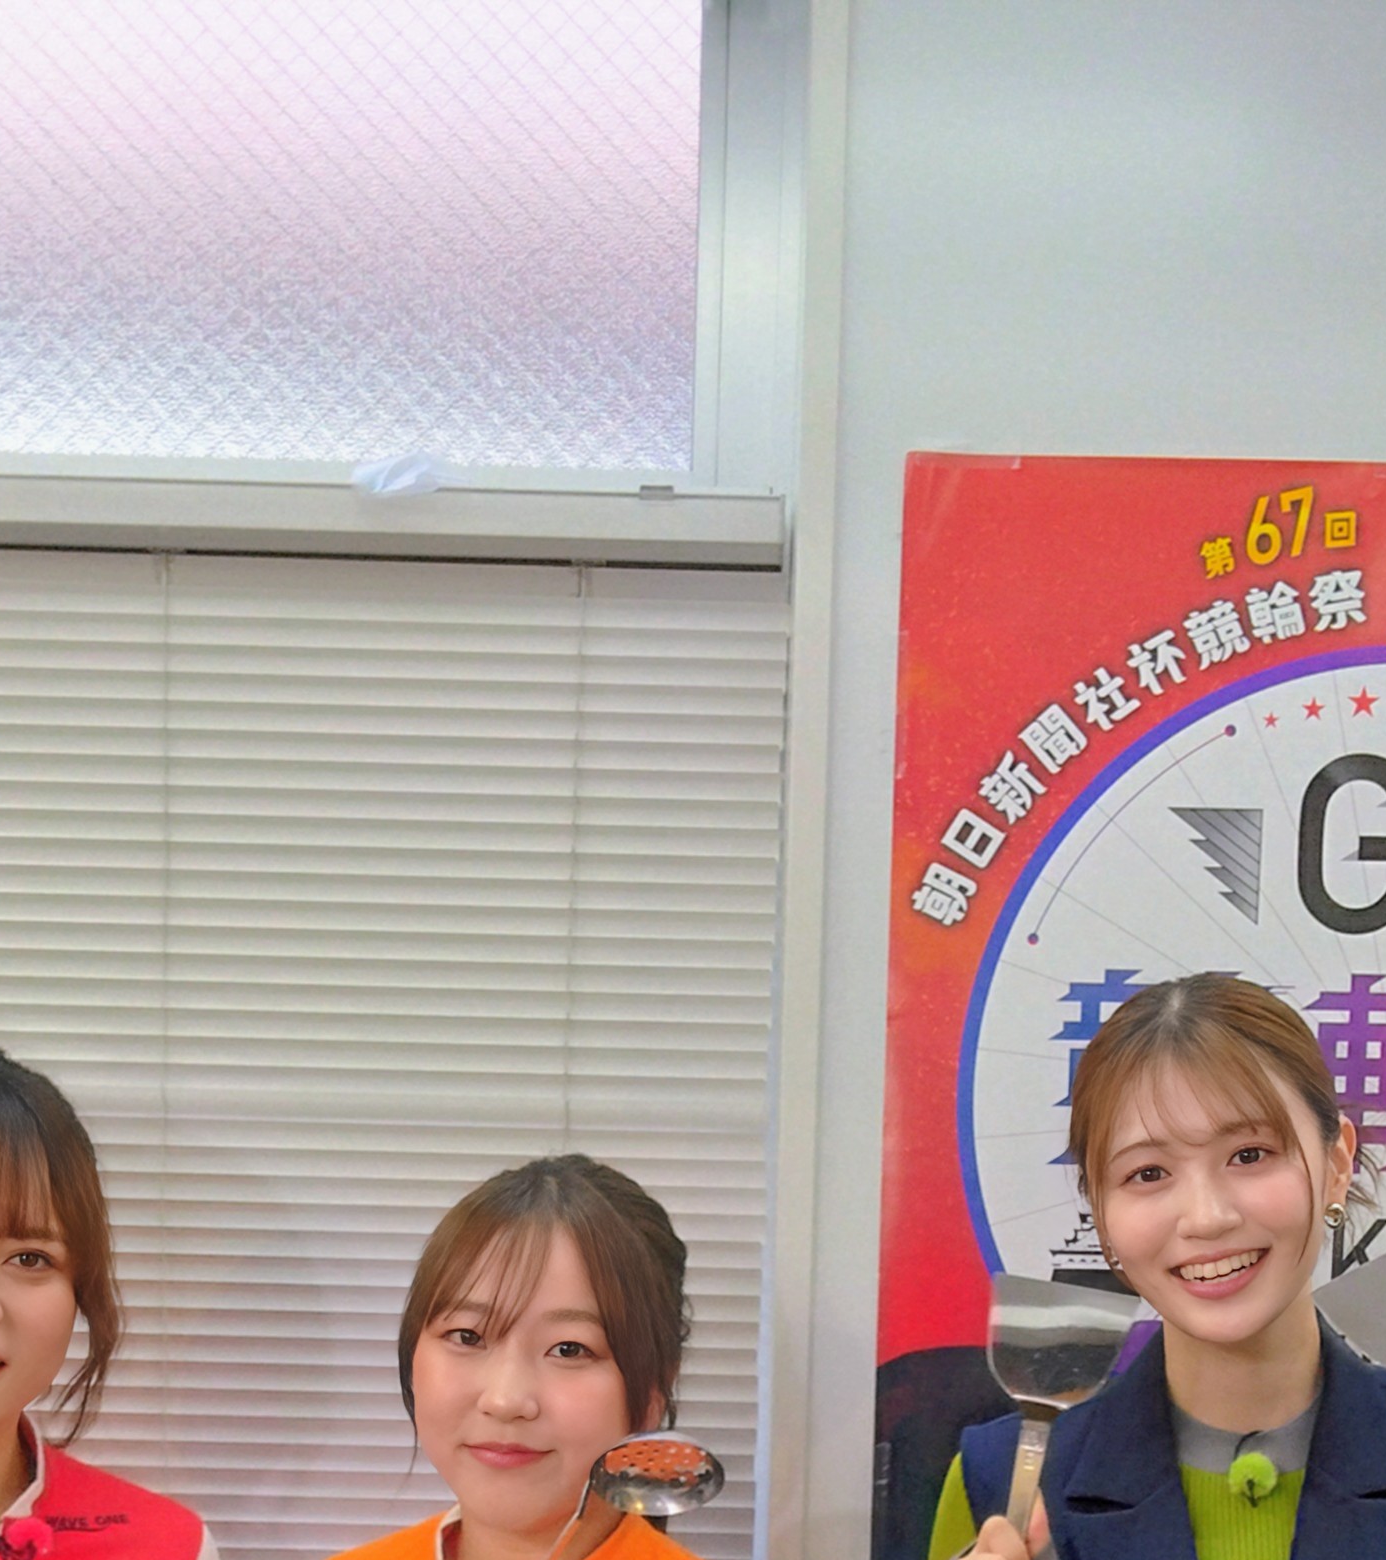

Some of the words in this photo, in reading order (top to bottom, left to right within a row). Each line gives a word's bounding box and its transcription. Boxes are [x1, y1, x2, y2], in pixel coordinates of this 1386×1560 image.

[1199, 486, 1358, 580] 第67回
[911, 570, 1368, 927] 朝日新聞社杯競輪祭
